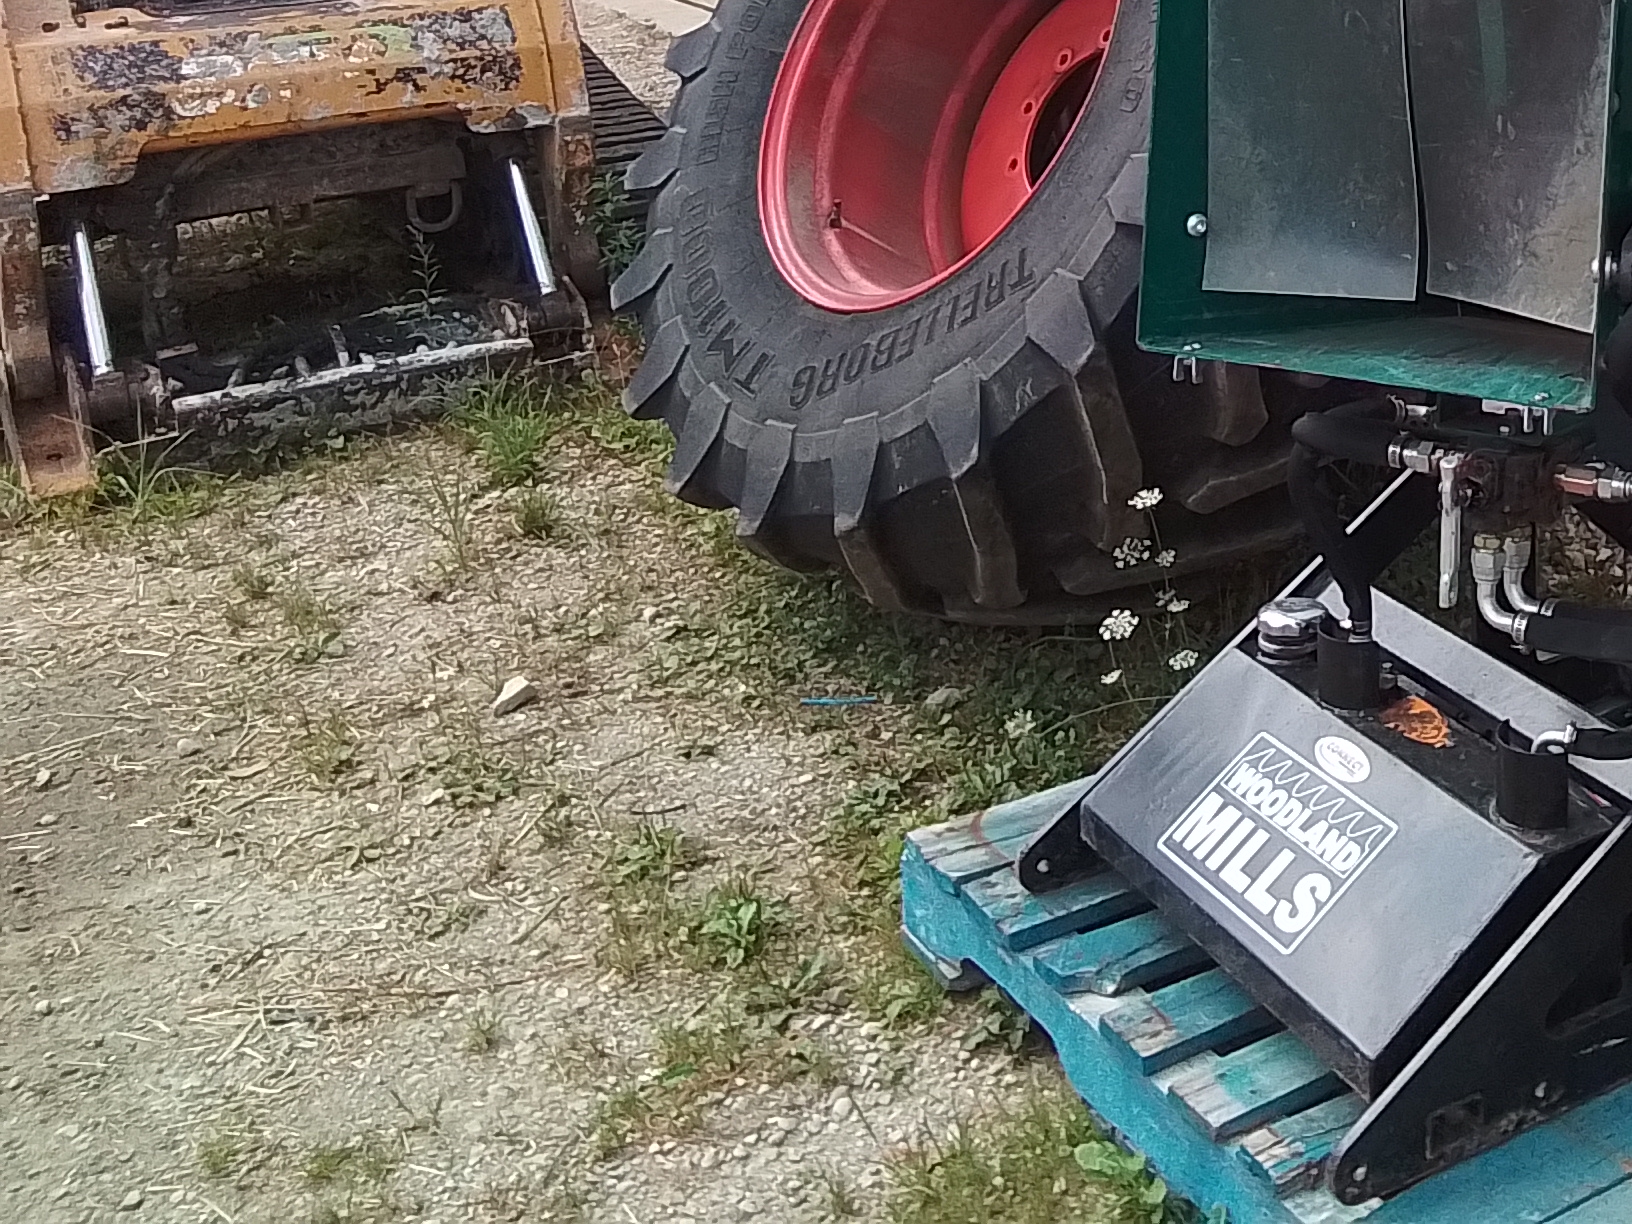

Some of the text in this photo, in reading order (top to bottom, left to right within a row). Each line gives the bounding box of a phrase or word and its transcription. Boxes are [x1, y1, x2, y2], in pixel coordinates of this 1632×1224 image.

[789, 248, 1037, 412] TRELLEBORG
[1171, 791, 1333, 934] MILLS
[1228, 761, 1362, 873] WOODLAND
